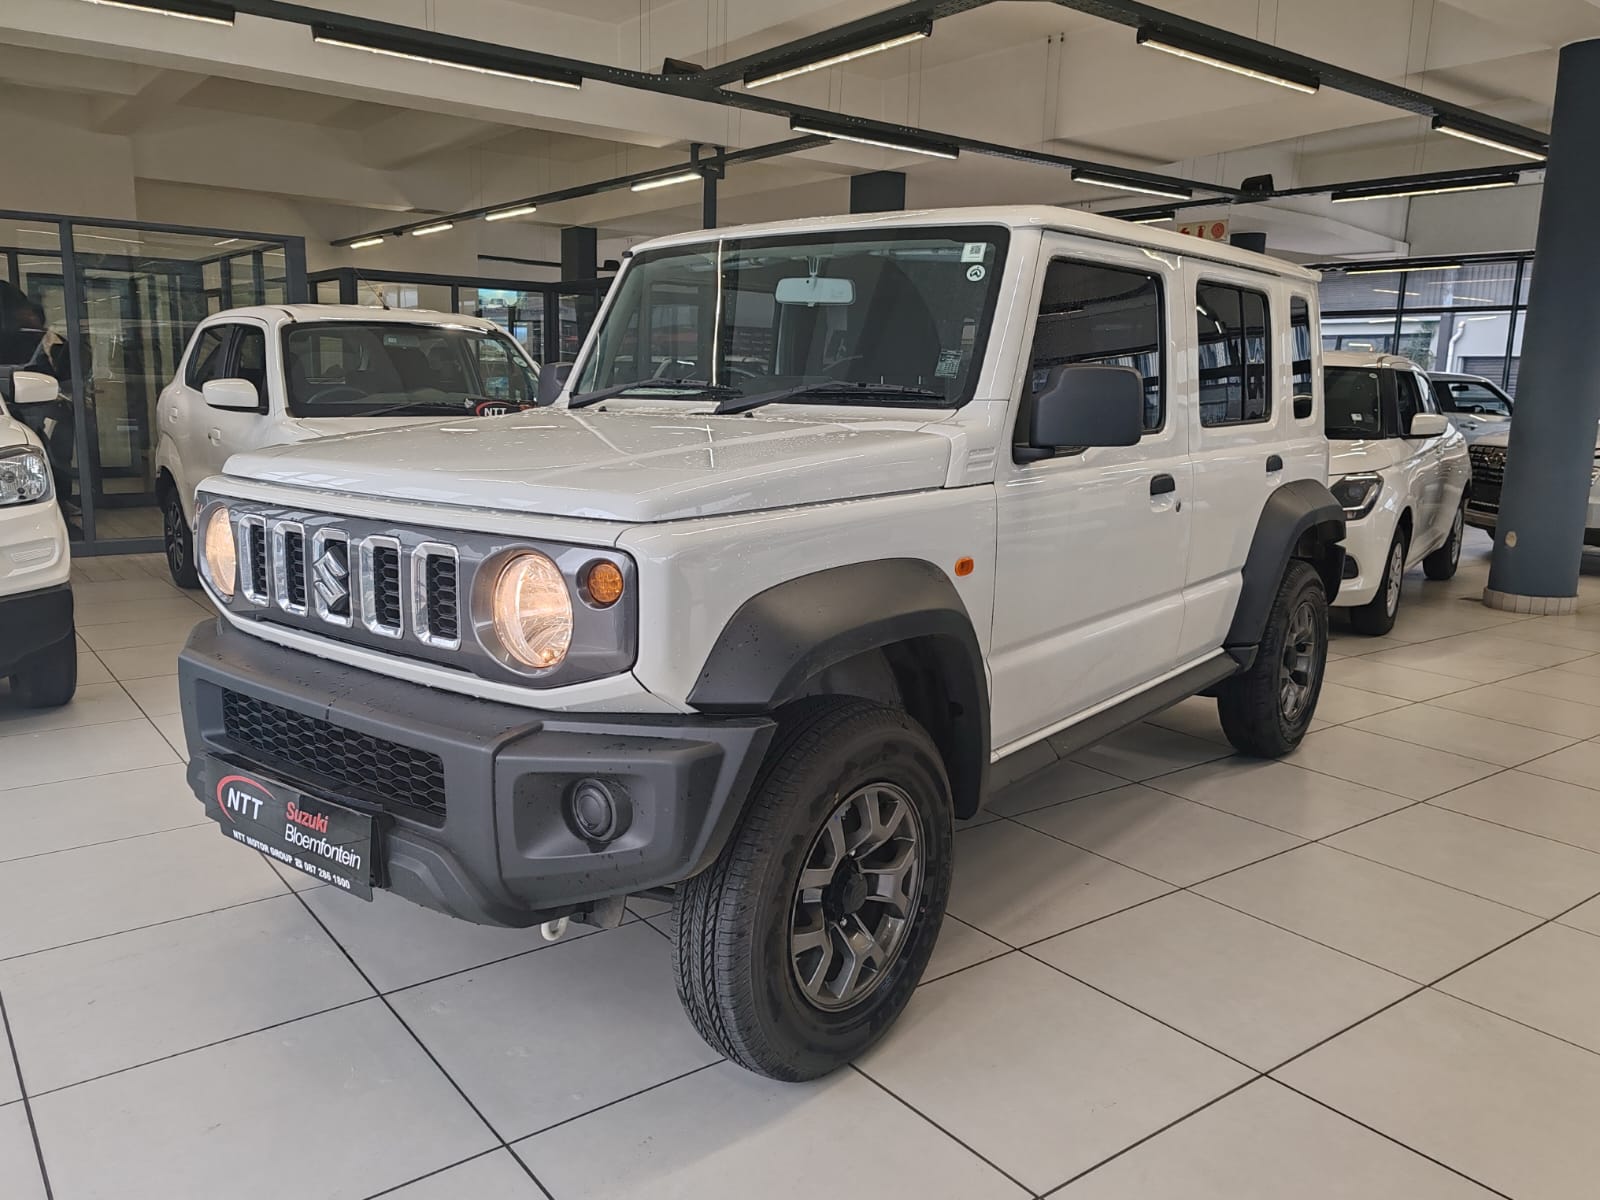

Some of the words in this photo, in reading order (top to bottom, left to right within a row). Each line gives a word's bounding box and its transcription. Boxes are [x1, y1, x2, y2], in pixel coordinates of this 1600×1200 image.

[484, 407, 507, 417] NTT
[227, 787, 264, 820] NTT
[286, 801, 329, 834] Suzuki
[232, 829, 246, 843] NTT
[246, 835, 270, 854] MOTOR
[269, 846, 293, 864] GROUP
[284, 823, 361, 870] Bloemfontein
